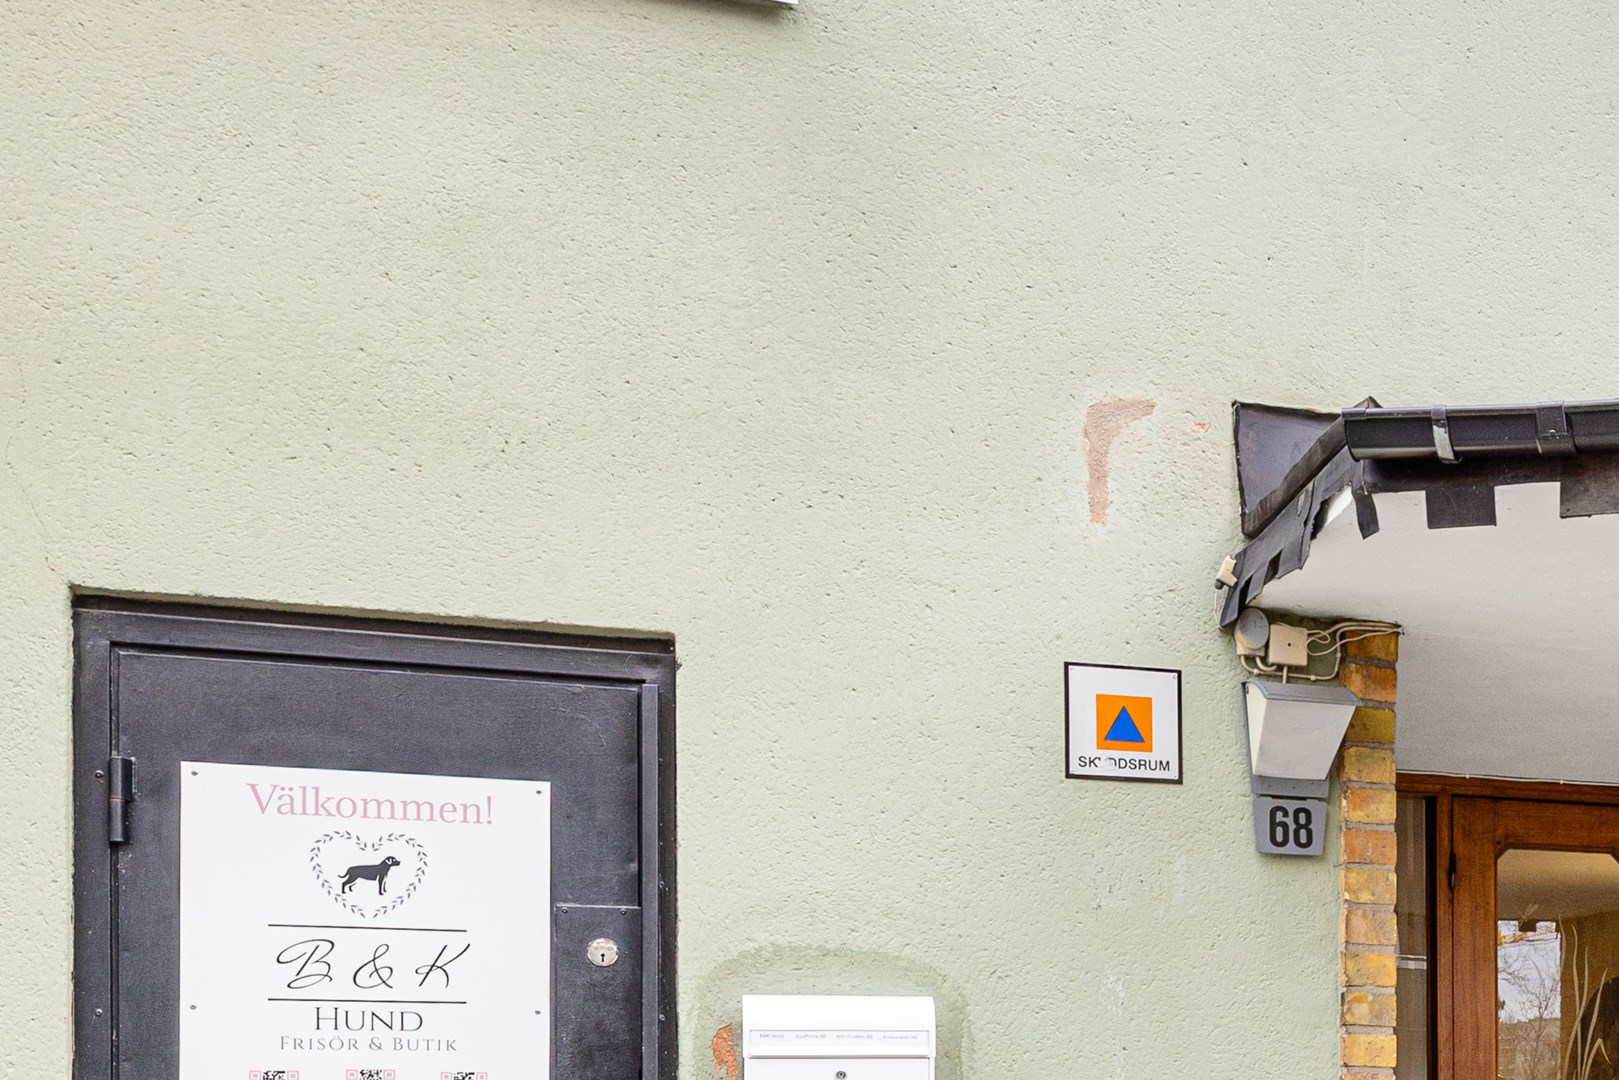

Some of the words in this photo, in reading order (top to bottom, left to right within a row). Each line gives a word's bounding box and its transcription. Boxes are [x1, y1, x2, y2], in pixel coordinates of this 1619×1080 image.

[1078, 755, 1170, 772] SKDSRUM
[247, 783, 494, 825] Välkommen!
[1269, 805, 1314, 849] 68
[276, 938, 336, 990] B
[352, 943, 393, 990] &
[415, 943, 471, 989] K
[314, 1006, 424, 1032] HUND
[280, 1034, 359, 1052] FRISÖR
[368, 1036, 384, 1051] &
[392, 1037, 458, 1052] BUTIK
